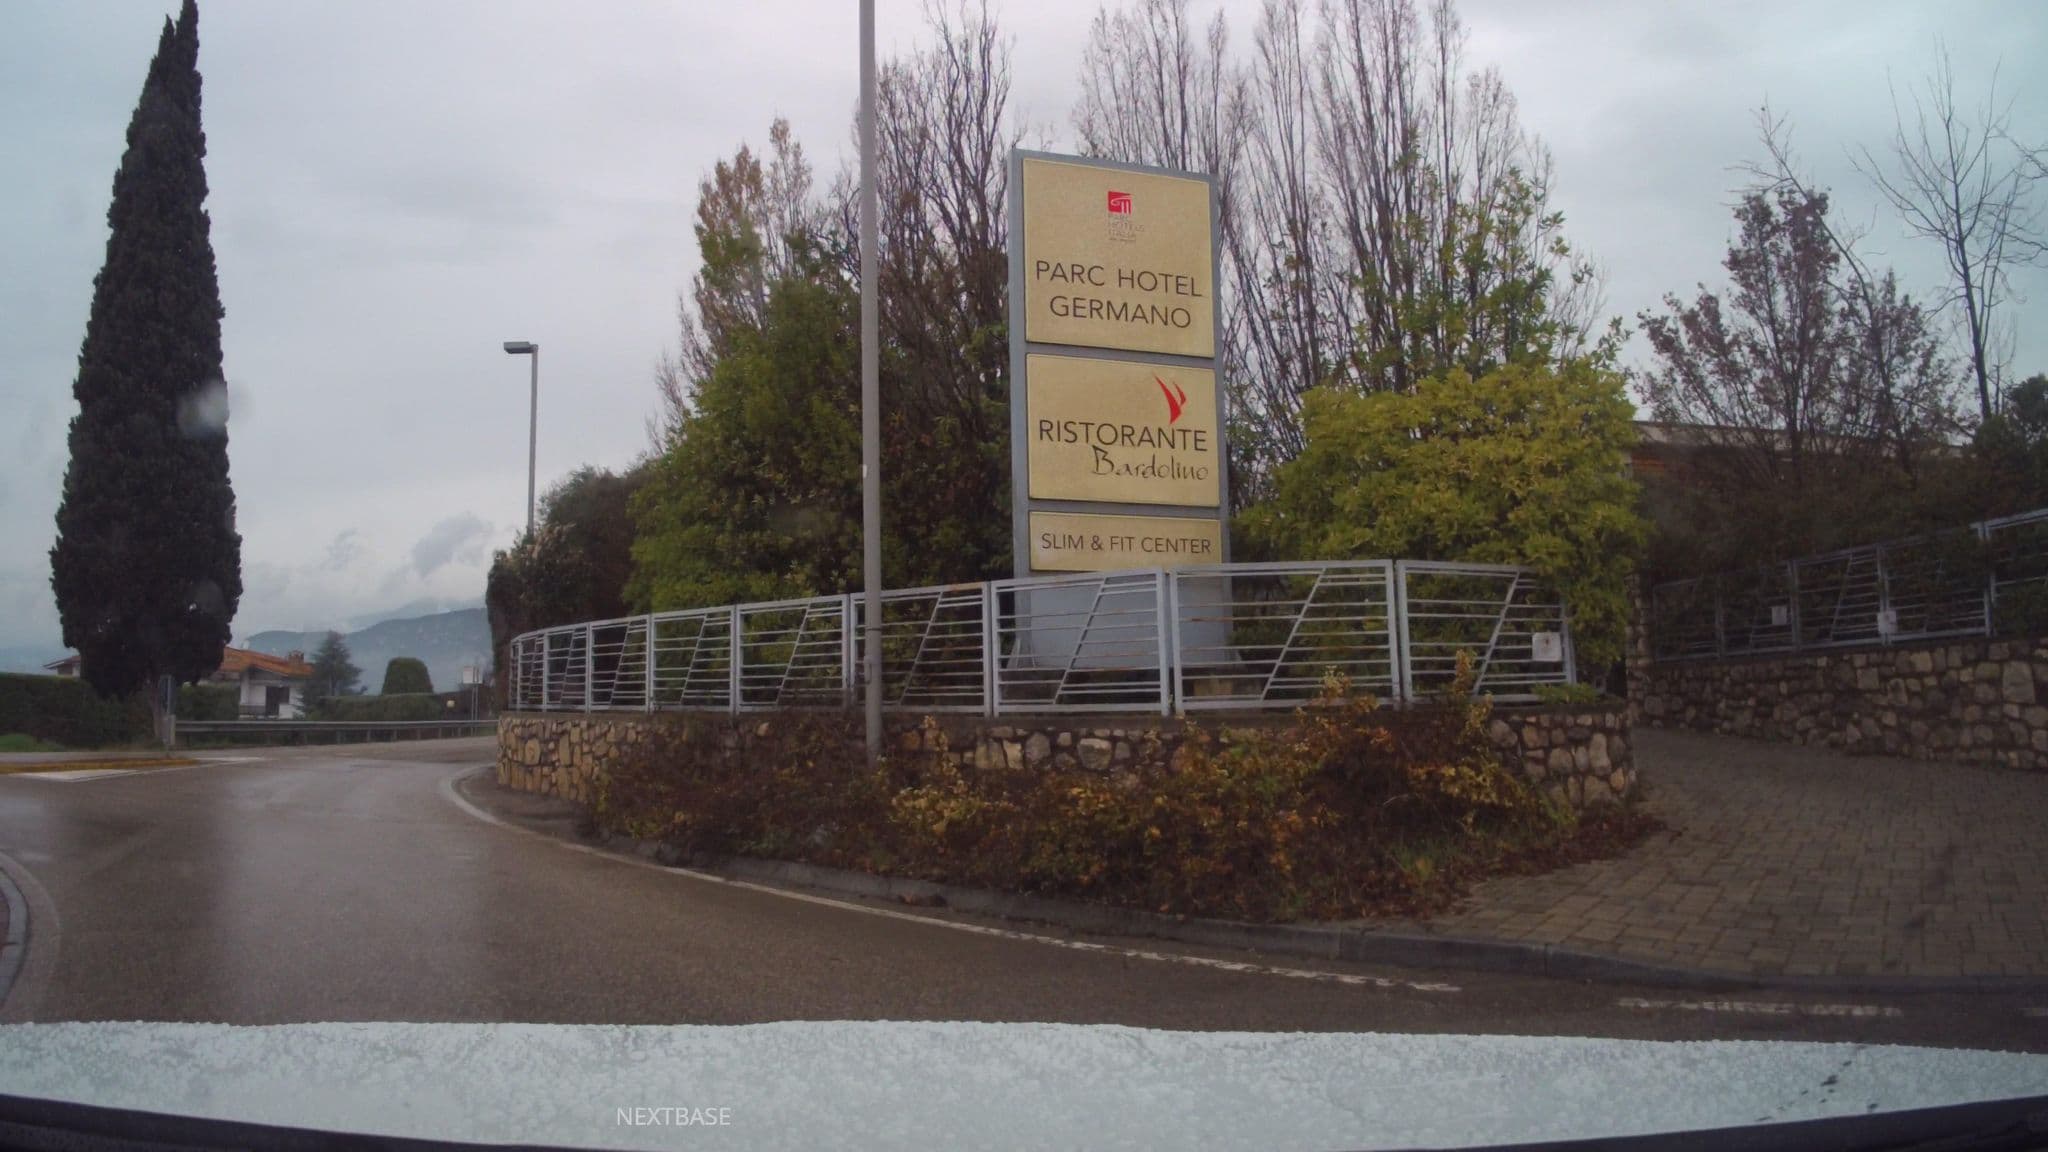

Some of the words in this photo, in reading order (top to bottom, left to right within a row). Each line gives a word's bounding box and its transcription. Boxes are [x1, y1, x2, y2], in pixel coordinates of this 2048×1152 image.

[1036, 260, 1105, 287] PARC
[1118, 268, 1203, 297] HOTEL
[1049, 295, 1191, 328] GERMANO
[1039, 419, 1208, 452] RISTORANTE
[1091, 444, 1209, 481] Bardolino
[1041, 532, 1084, 550] SLIM
[1090, 534, 1103, 550] &
[1110, 535, 1135, 551] FIT
[1141, 537, 1212, 554] CENTER
